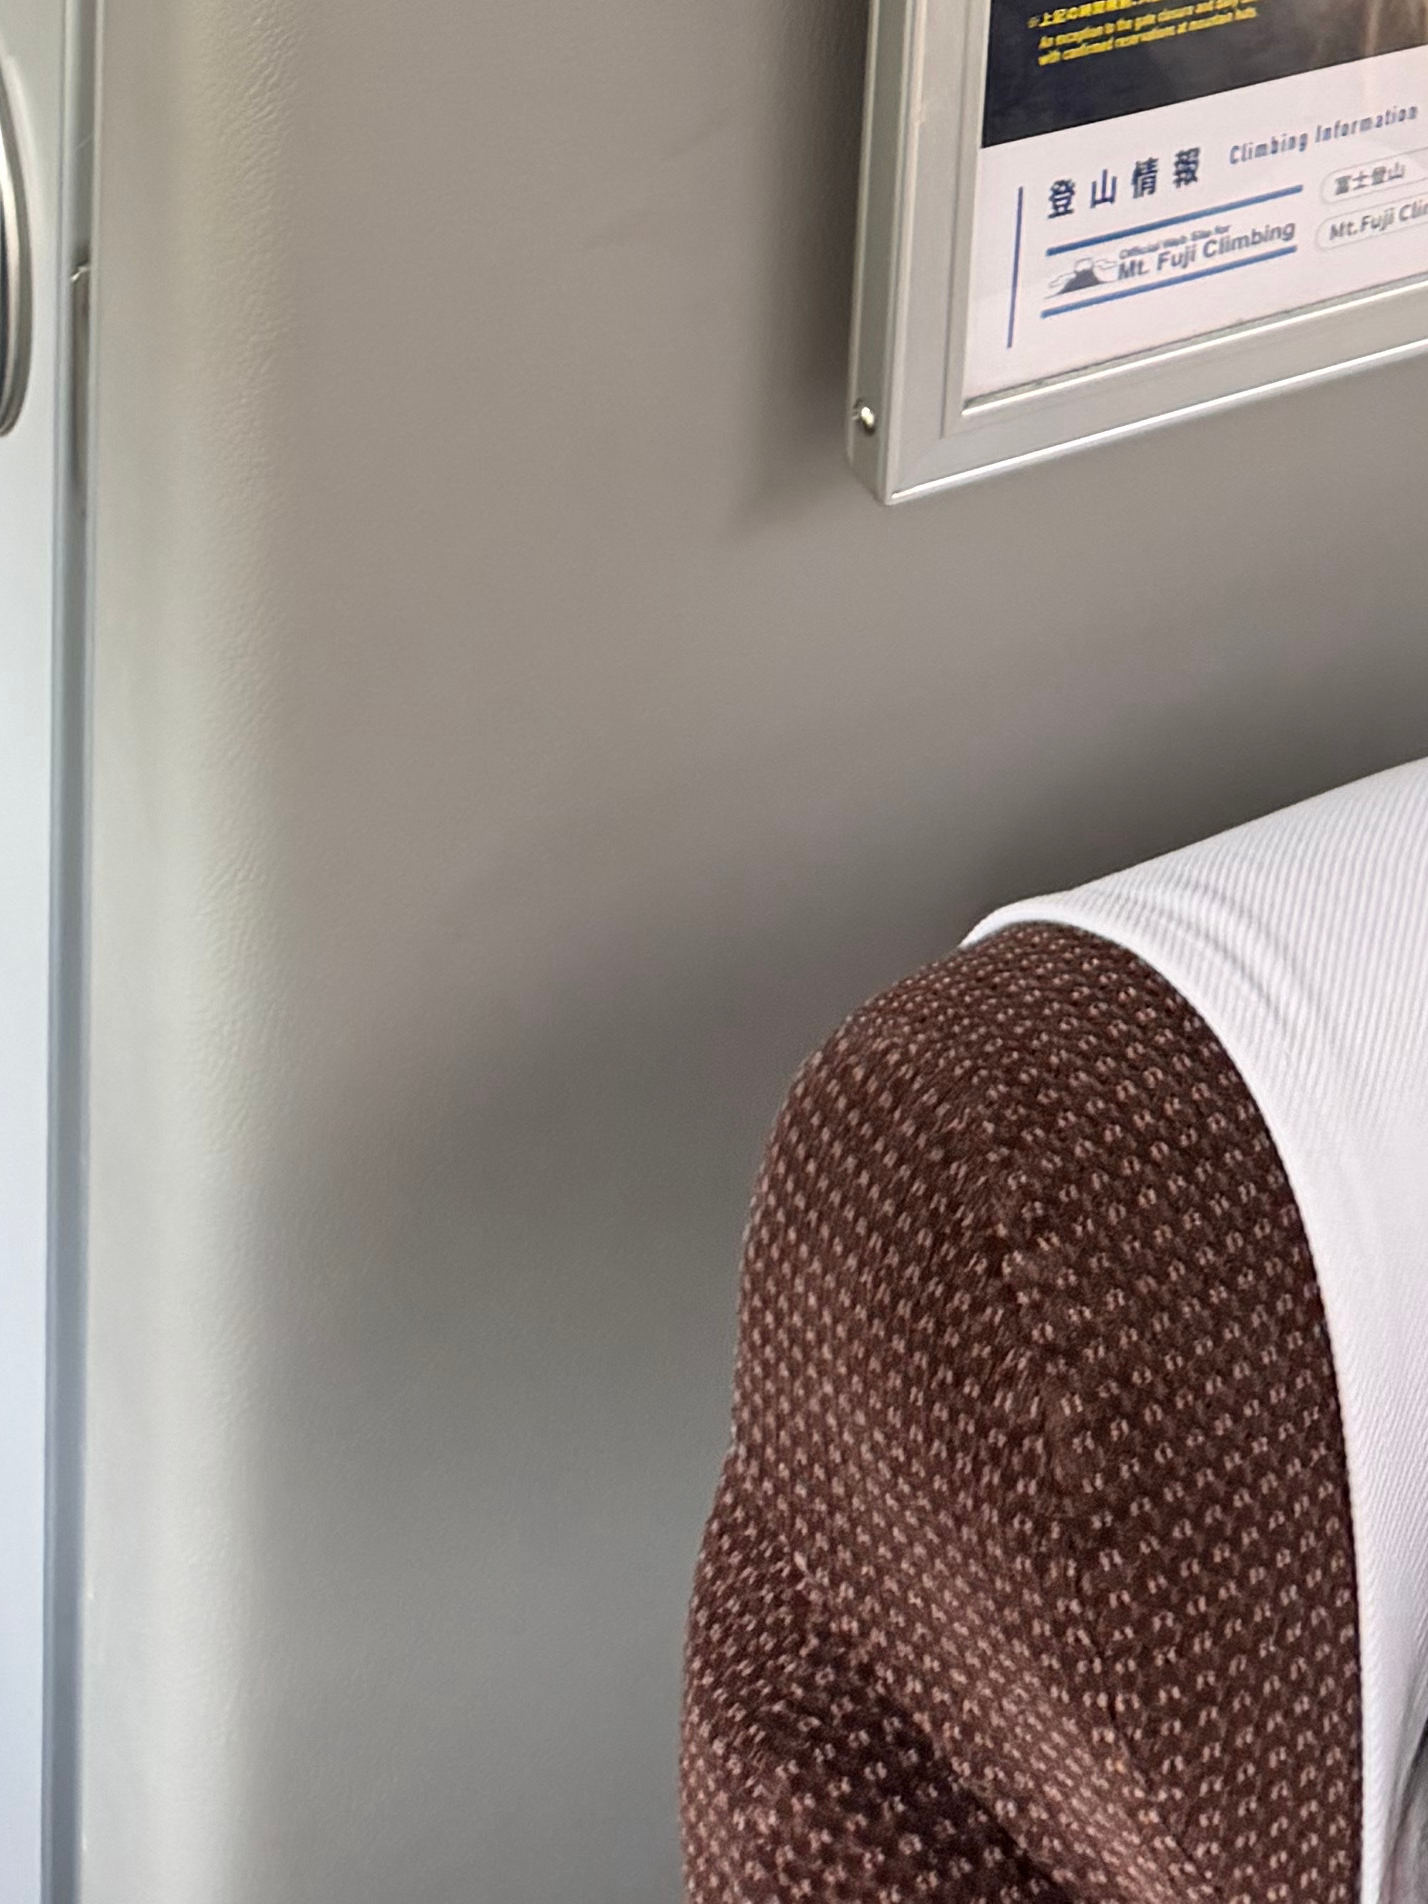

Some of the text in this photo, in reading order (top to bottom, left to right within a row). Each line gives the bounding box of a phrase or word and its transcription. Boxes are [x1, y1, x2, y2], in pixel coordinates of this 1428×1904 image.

[1229, 103, 1420, 166] Climbing Information
[1047, 146, 1202, 219] 登山情報
[1155, 244, 1197, 272] Fuji
[1201, 222, 1297, 259] Climbing
